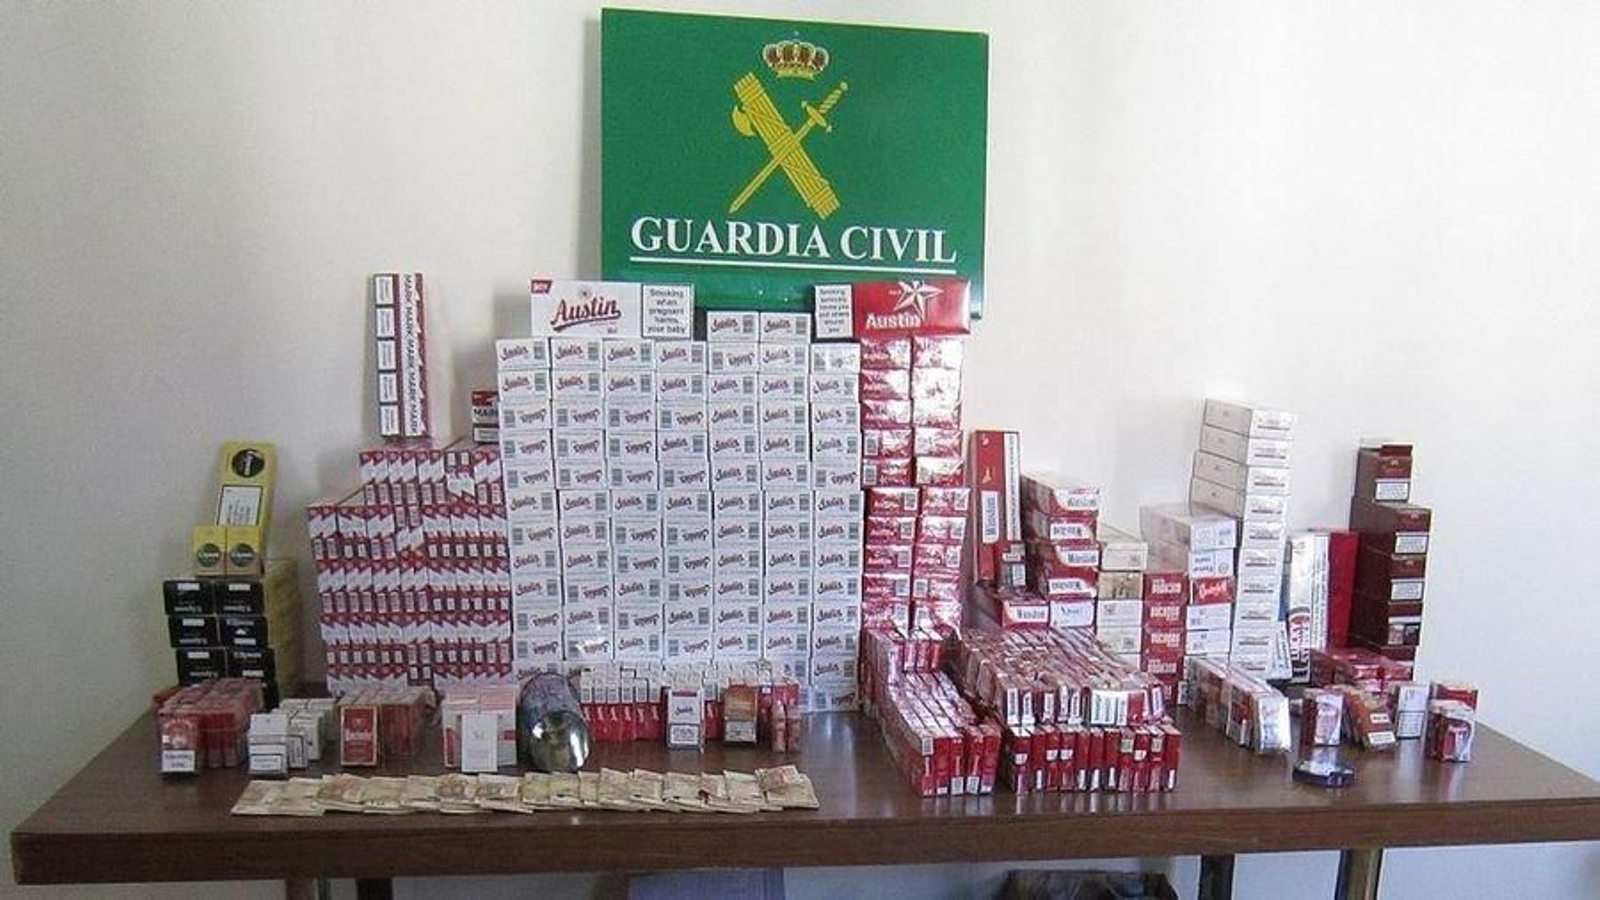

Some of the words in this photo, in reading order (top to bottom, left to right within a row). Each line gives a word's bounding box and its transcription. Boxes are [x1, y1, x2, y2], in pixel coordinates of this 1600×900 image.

[631, 216, 831, 259] GUARDIA
[840, 226, 957, 263] CIVIL
[404, 274, 412, 304] MARK
[650, 289, 684, 299] Smoking
[405, 306, 413, 337] MARK
[551, 297, 622, 330] Austin
[649, 308, 684, 316] pregnant
[865, 313, 921, 329] Austin
[648, 326, 665, 334] your
[667, 325, 686, 334] baby
[407, 339, 415, 369] MARK
[408, 372, 416, 402] MARK
[410, 403, 418, 433] MARK
[985, 497, 996, 536] Winston
